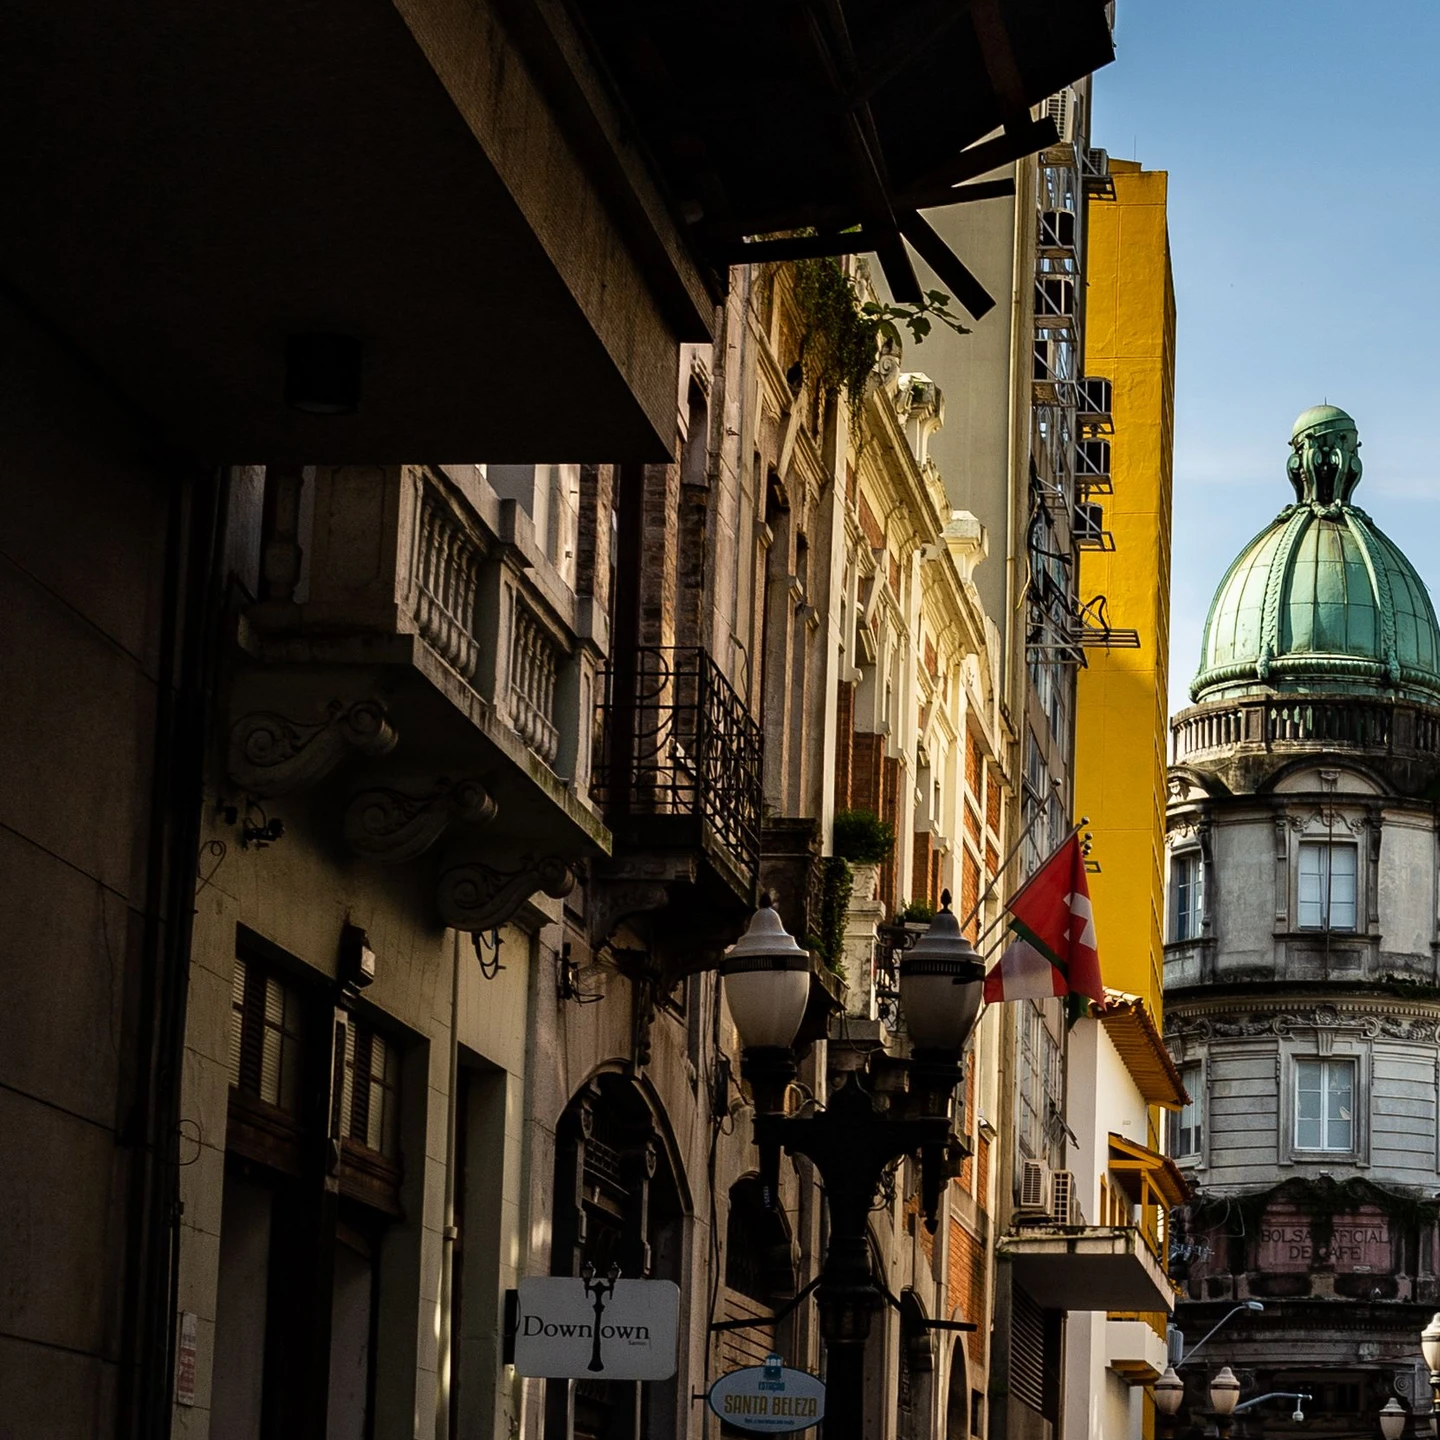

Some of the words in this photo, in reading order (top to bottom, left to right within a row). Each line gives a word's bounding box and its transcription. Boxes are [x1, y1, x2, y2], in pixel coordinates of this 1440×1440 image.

[1261, 1229, 1313, 1244] BOLSA
[1289, 1246, 1312, 1260] DE
[724, 1394, 768, 1415] SANTA
[772, 1396, 817, 1418] BELEZA
